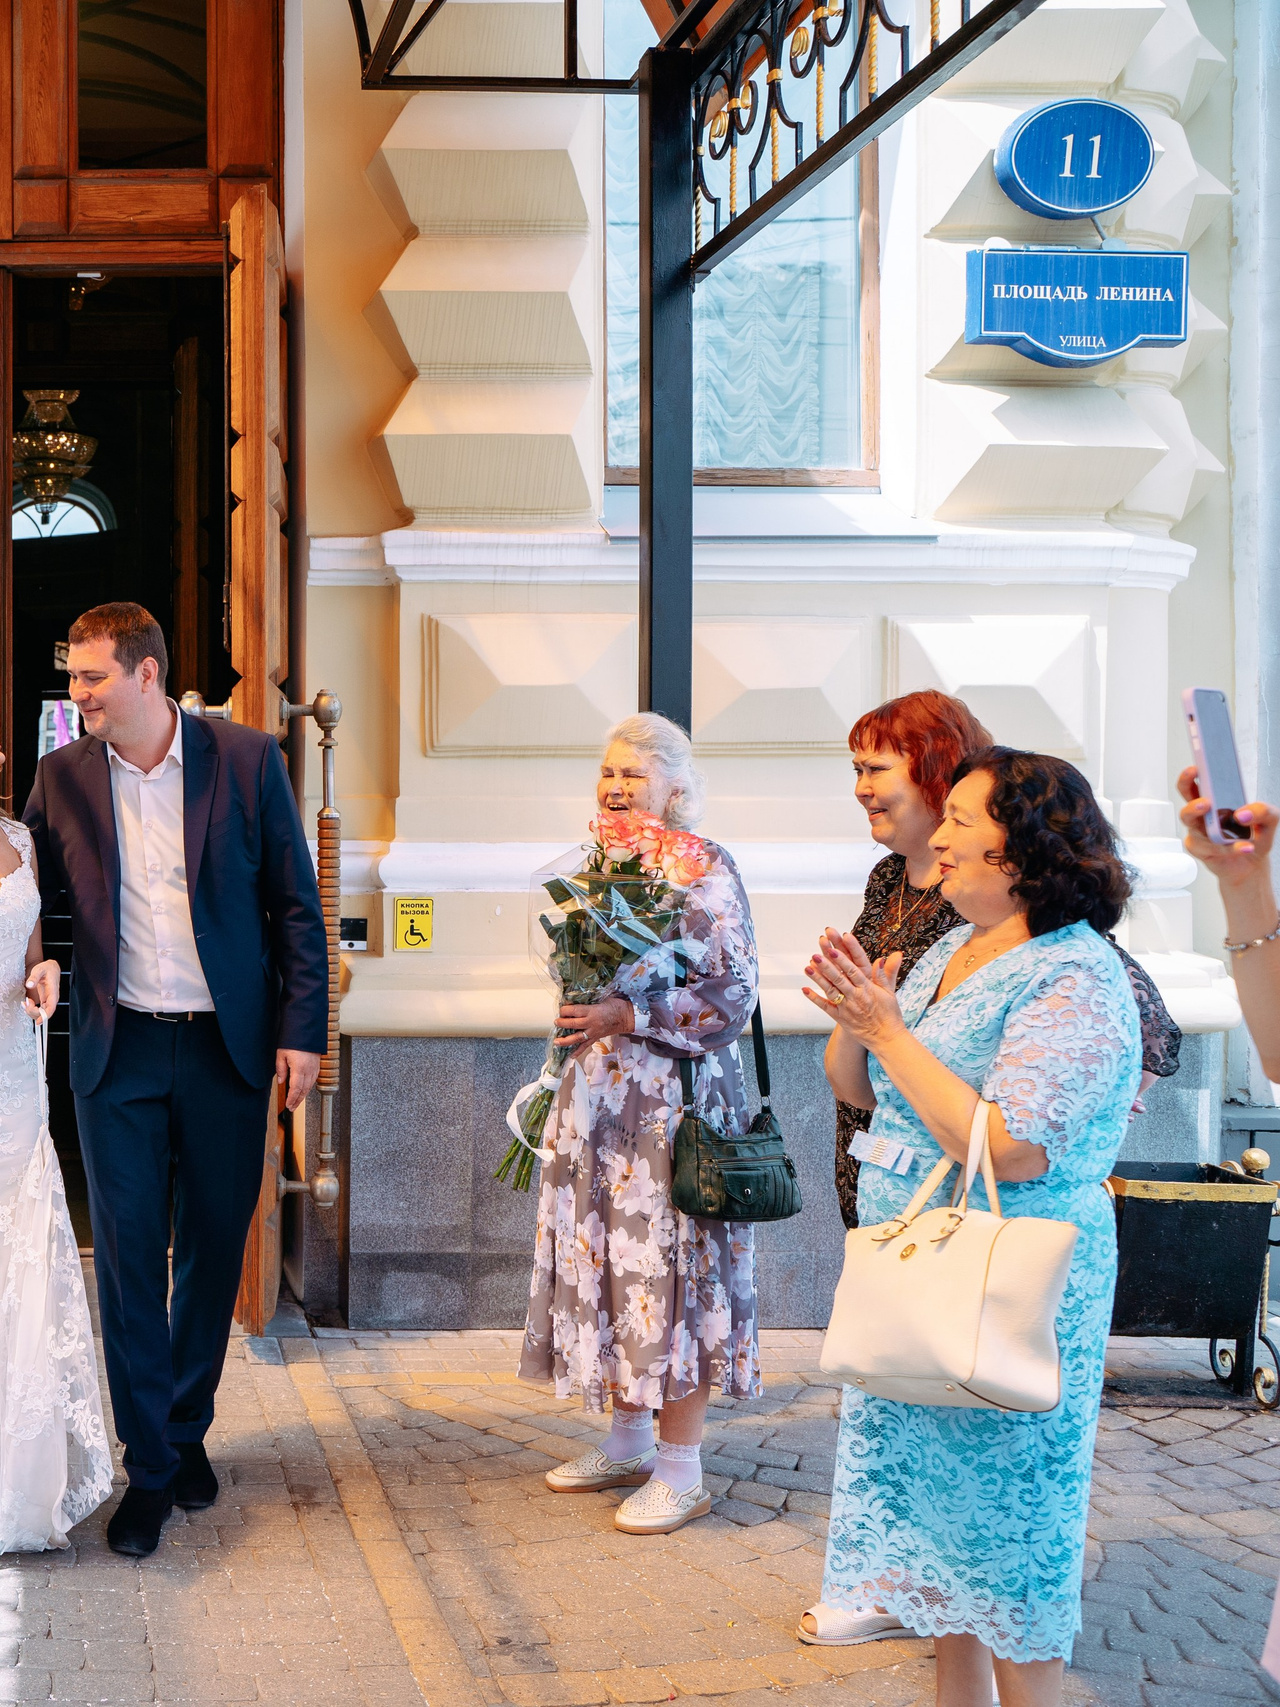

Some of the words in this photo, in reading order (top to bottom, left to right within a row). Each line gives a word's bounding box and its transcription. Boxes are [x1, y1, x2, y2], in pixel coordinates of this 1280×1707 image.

[1058, 133, 1102, 178] 11
[992, 284, 1088, 302] ПЛОЩАДЬ
[1095, 286, 1174, 301] ЛЕНИНА
[1059, 335, 1107, 347] УЛИЦА
